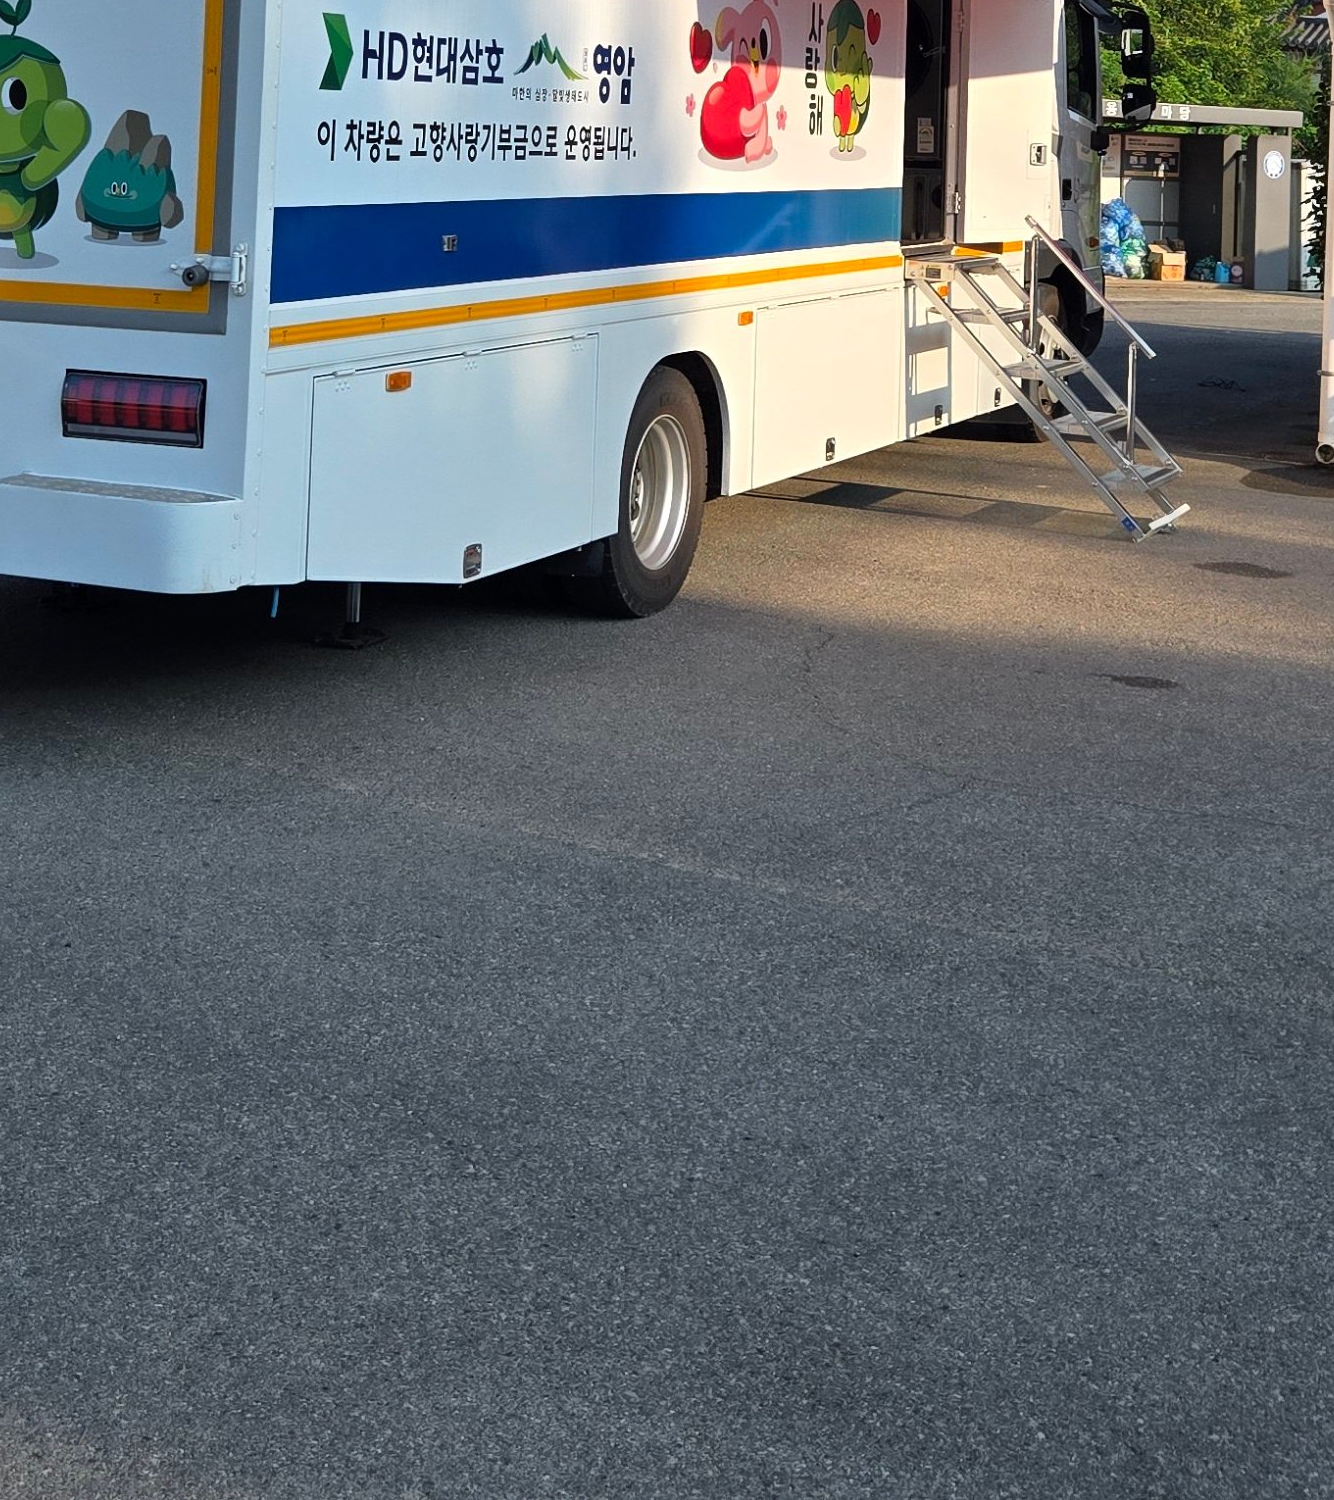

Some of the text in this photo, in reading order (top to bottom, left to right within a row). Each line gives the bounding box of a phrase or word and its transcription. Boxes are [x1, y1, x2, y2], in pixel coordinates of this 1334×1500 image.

[361, 29, 505, 85] HD현대삼호
[593, 44, 635, 104] 영암
[805, 1, 824, 136] 사랑해
[317, 119, 637, 163] 이 차량은 고향사랑기부금으로 운영됩니다.
